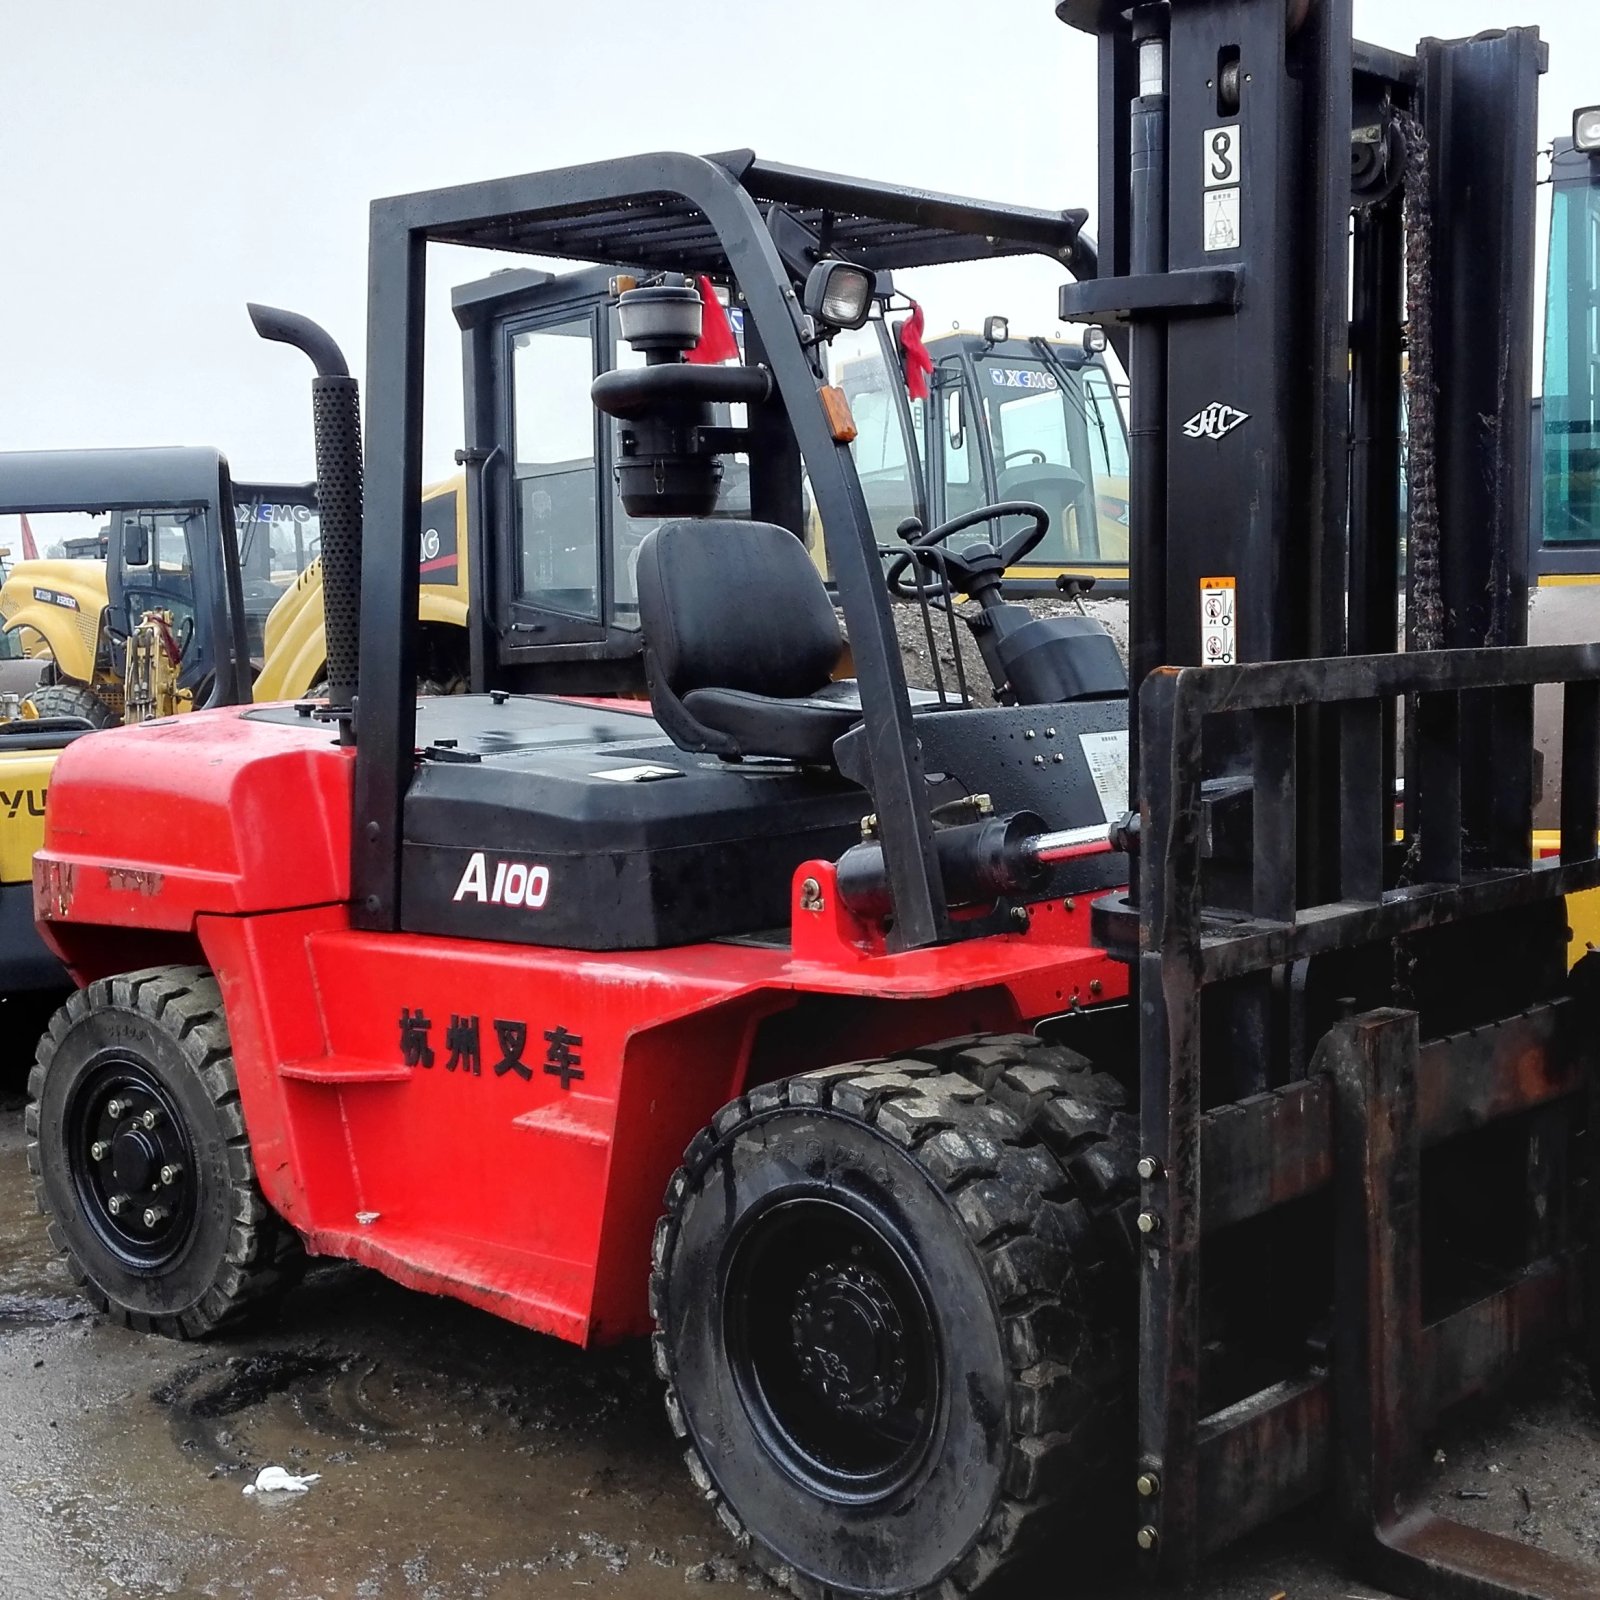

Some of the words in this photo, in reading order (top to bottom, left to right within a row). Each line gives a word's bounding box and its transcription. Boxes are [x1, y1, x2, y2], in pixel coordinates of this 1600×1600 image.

[1005, 369, 1058, 390] XCMG
[239, 503, 312, 524] XCMG
[420, 528, 440, 562] G
[453, 851, 550, 908] A100
[398, 1006, 585, 1090] 杭州叉车
